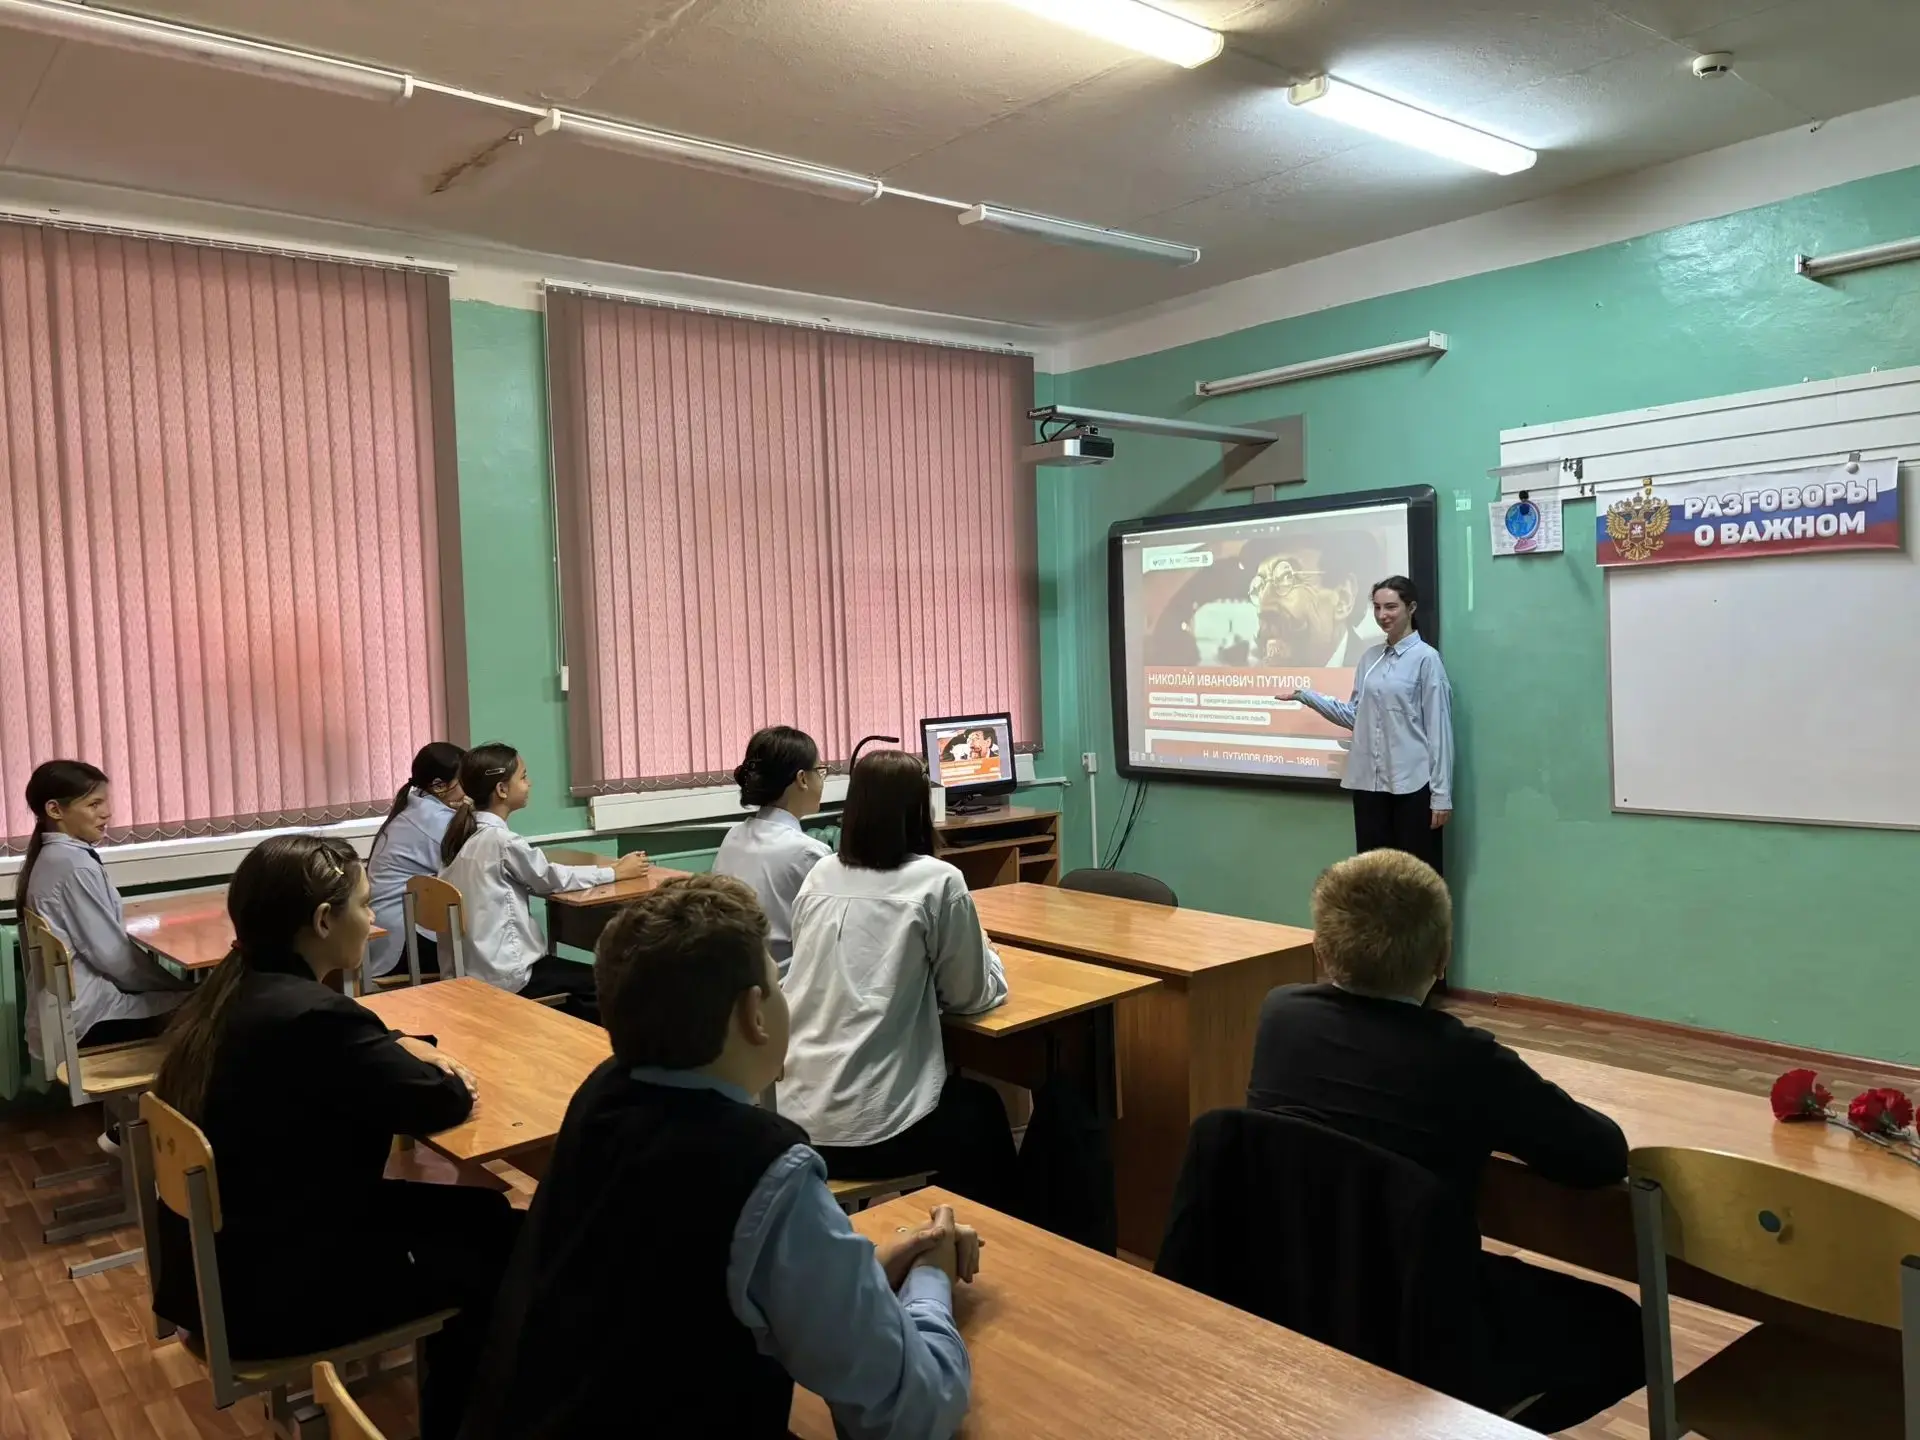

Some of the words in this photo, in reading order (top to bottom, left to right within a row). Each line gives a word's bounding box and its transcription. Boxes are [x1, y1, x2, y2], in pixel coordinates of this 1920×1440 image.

[1684, 478, 1877, 519] РАЗГОВОРЫ
[1695, 524, 1715, 546] О
[1721, 511, 1865, 545] ВАЖНОМ
[1149, 672, 1194, 686] НИКОЛАЙ
[1198, 675, 1252, 687] ИВАНОВИЧ
[1257, 676, 1311, 689] ПУТИЛОВ
